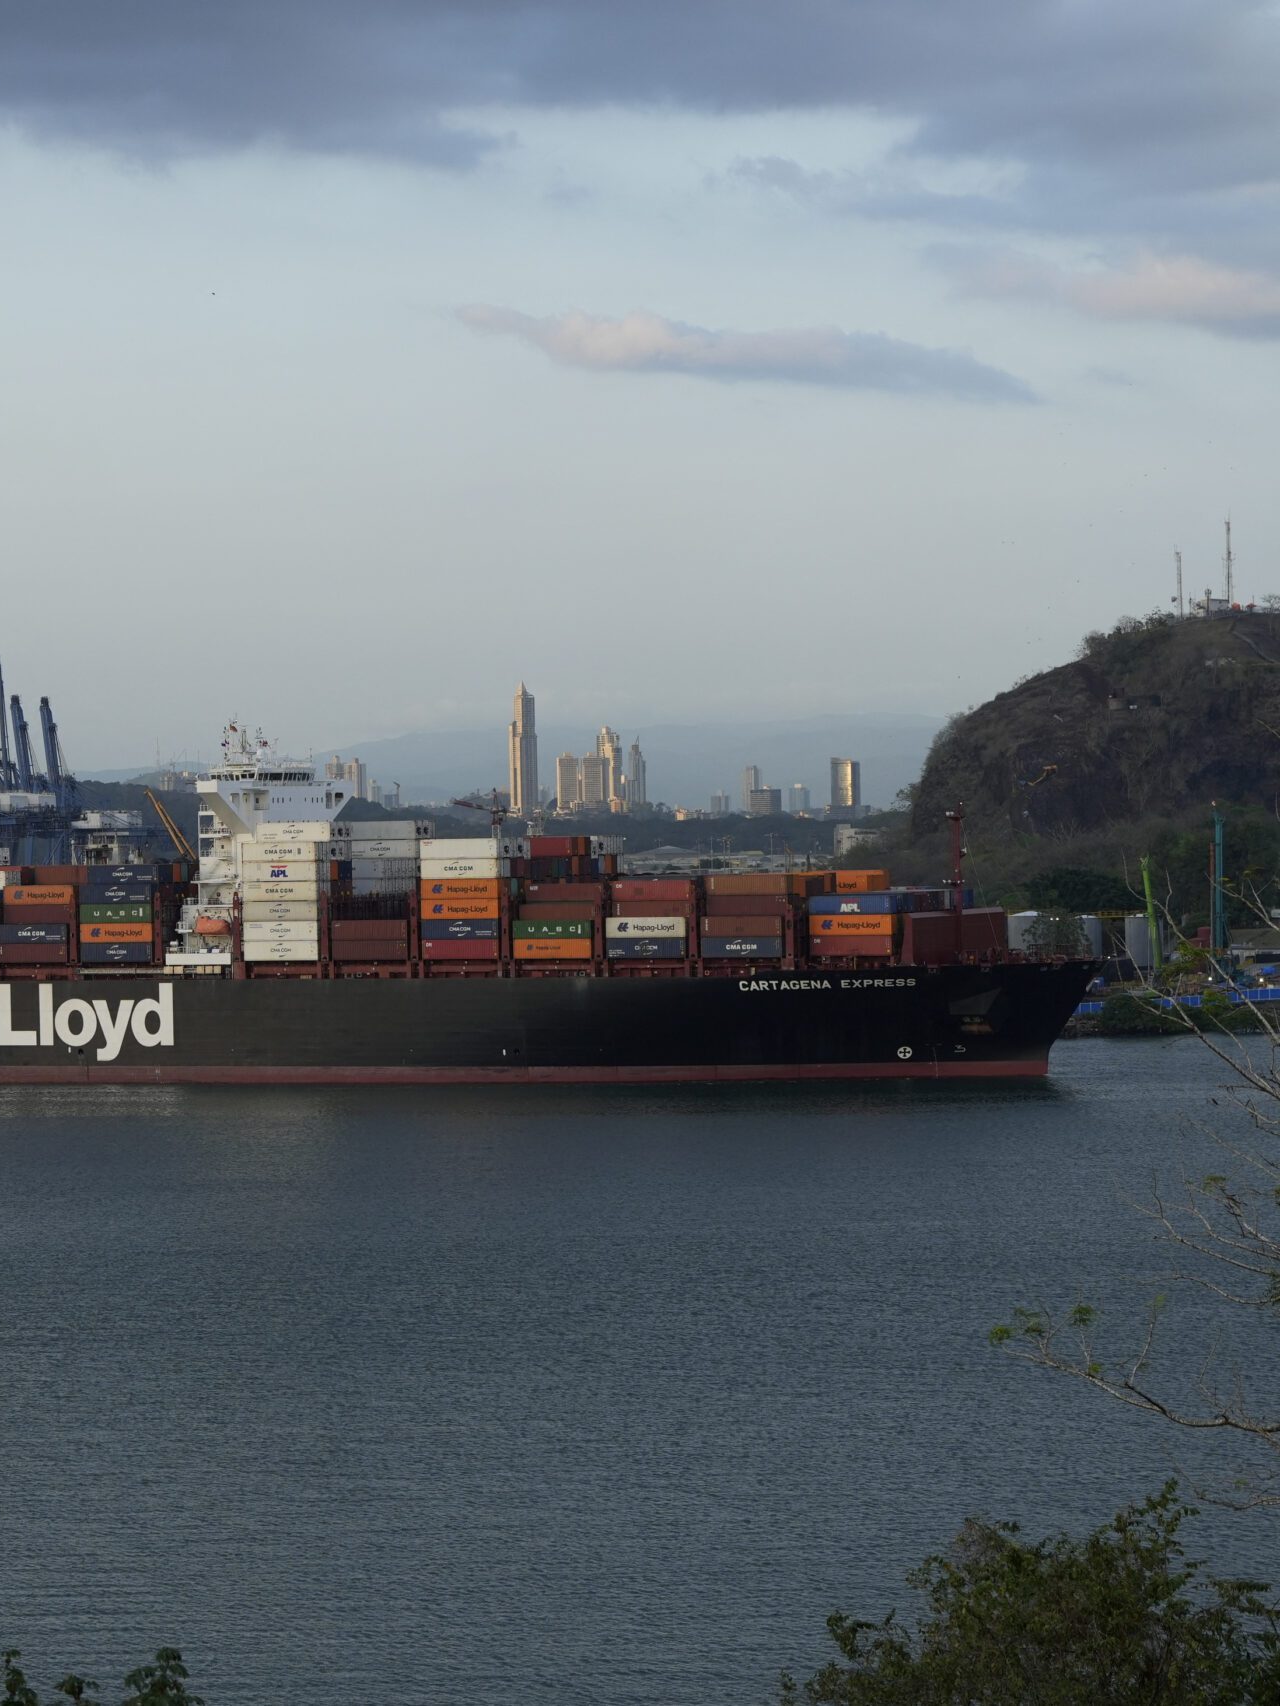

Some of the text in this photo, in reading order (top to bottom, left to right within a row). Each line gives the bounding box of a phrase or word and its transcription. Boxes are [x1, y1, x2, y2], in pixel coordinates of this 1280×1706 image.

[271, 870, 288, 878] APL
[840, 904, 860, 912] APL
[633, 924, 674, 932] Hapag-Lloyd
[739, 978, 916, 991] CARTAGENA EXPRESS
